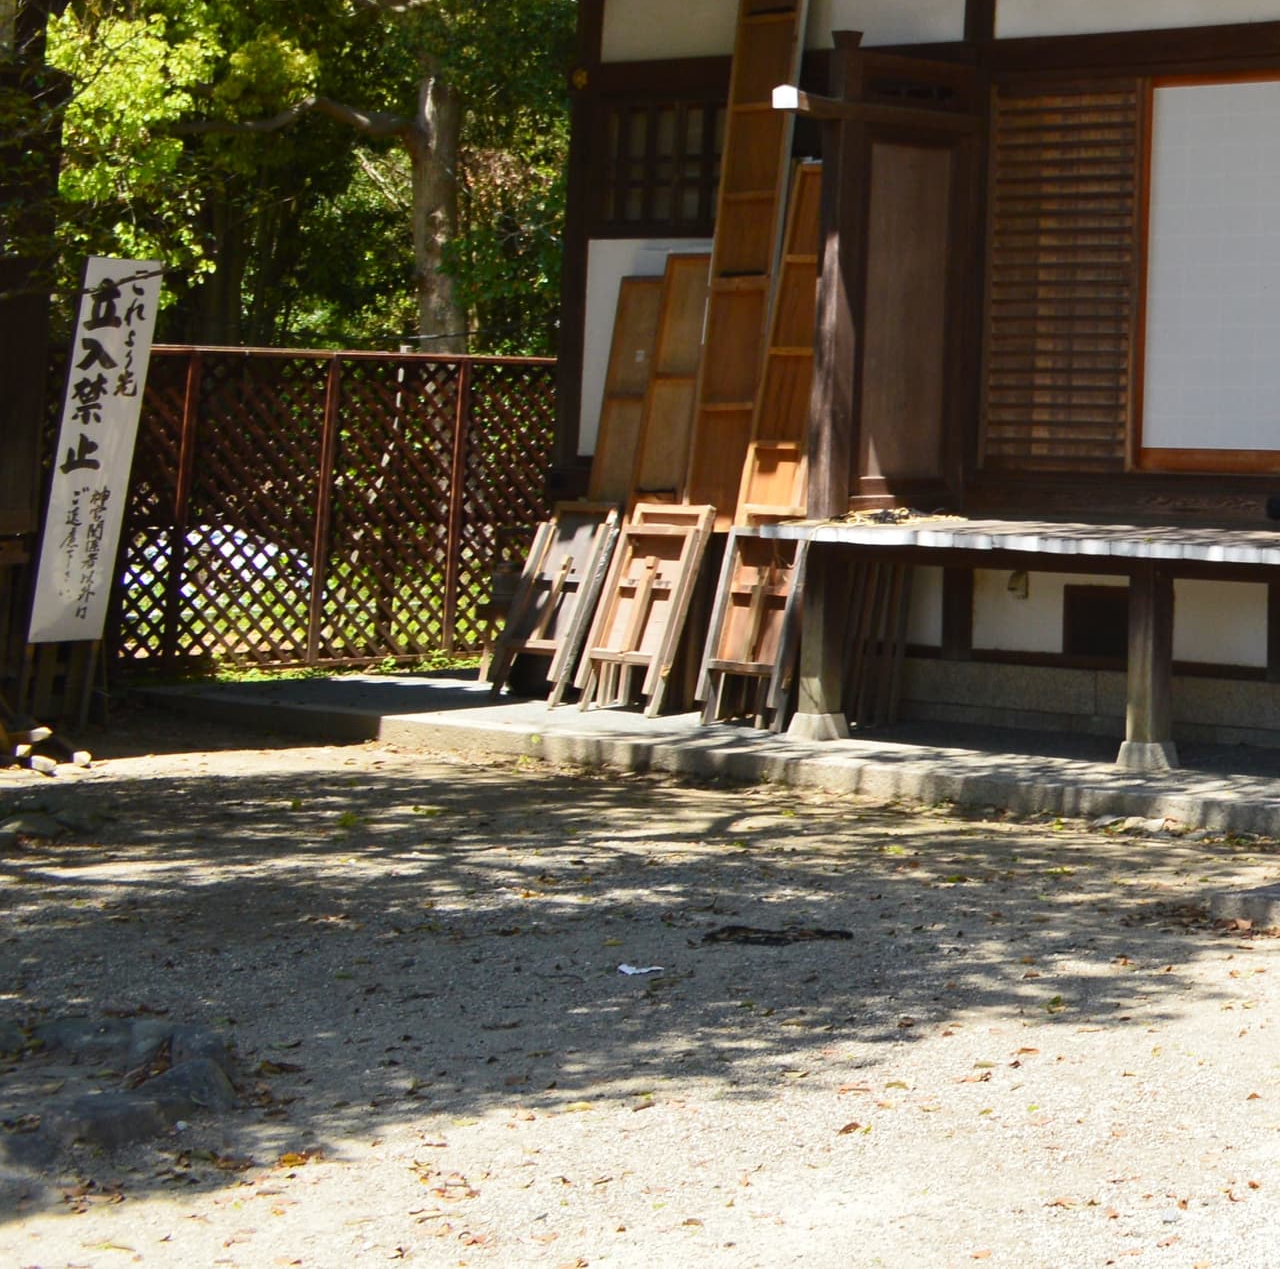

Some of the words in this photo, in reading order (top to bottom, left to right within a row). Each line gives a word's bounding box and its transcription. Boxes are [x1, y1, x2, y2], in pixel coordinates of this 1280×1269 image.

[59, 277, 123, 475] 立入禁止
[112, 270, 147, 398] これより先
